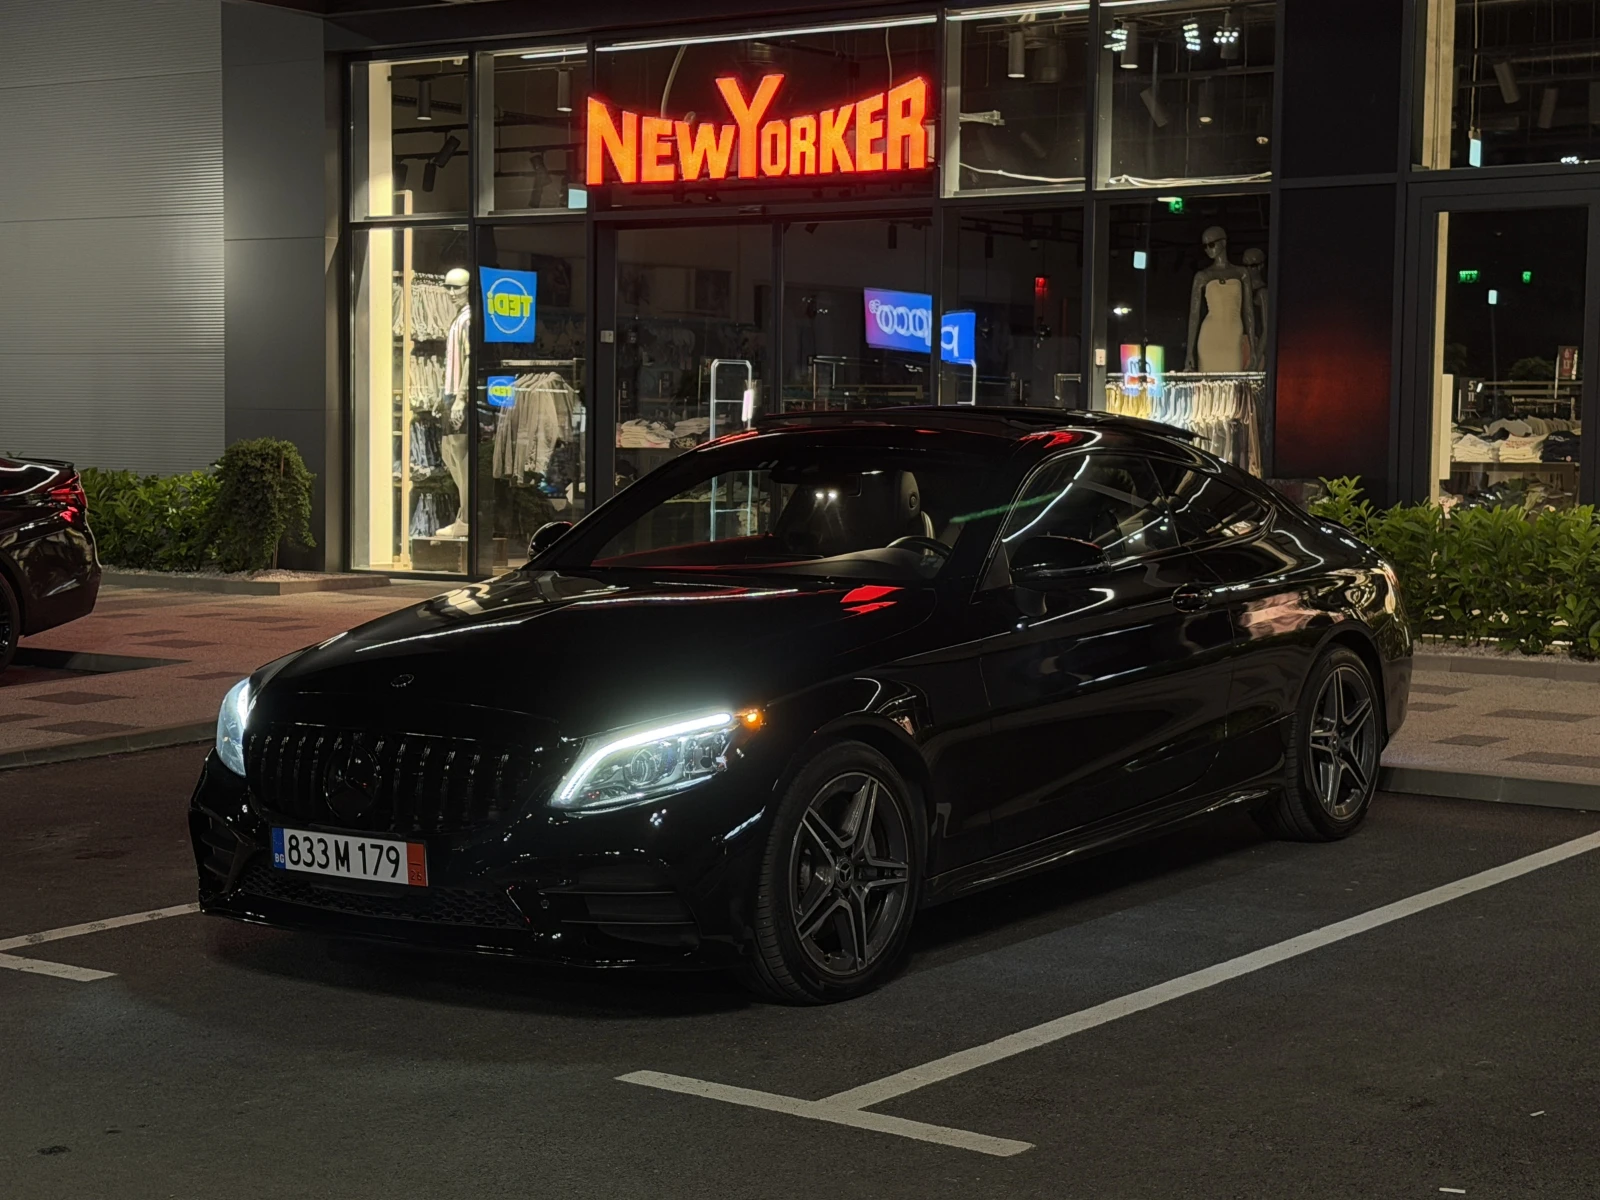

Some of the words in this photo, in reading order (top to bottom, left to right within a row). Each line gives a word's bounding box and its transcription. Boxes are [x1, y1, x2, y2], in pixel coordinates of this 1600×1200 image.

[274, 853, 285, 864] BG
[288, 834, 330, 869] 833
[334, 839, 351, 873] M
[357, 842, 400, 878] 179
